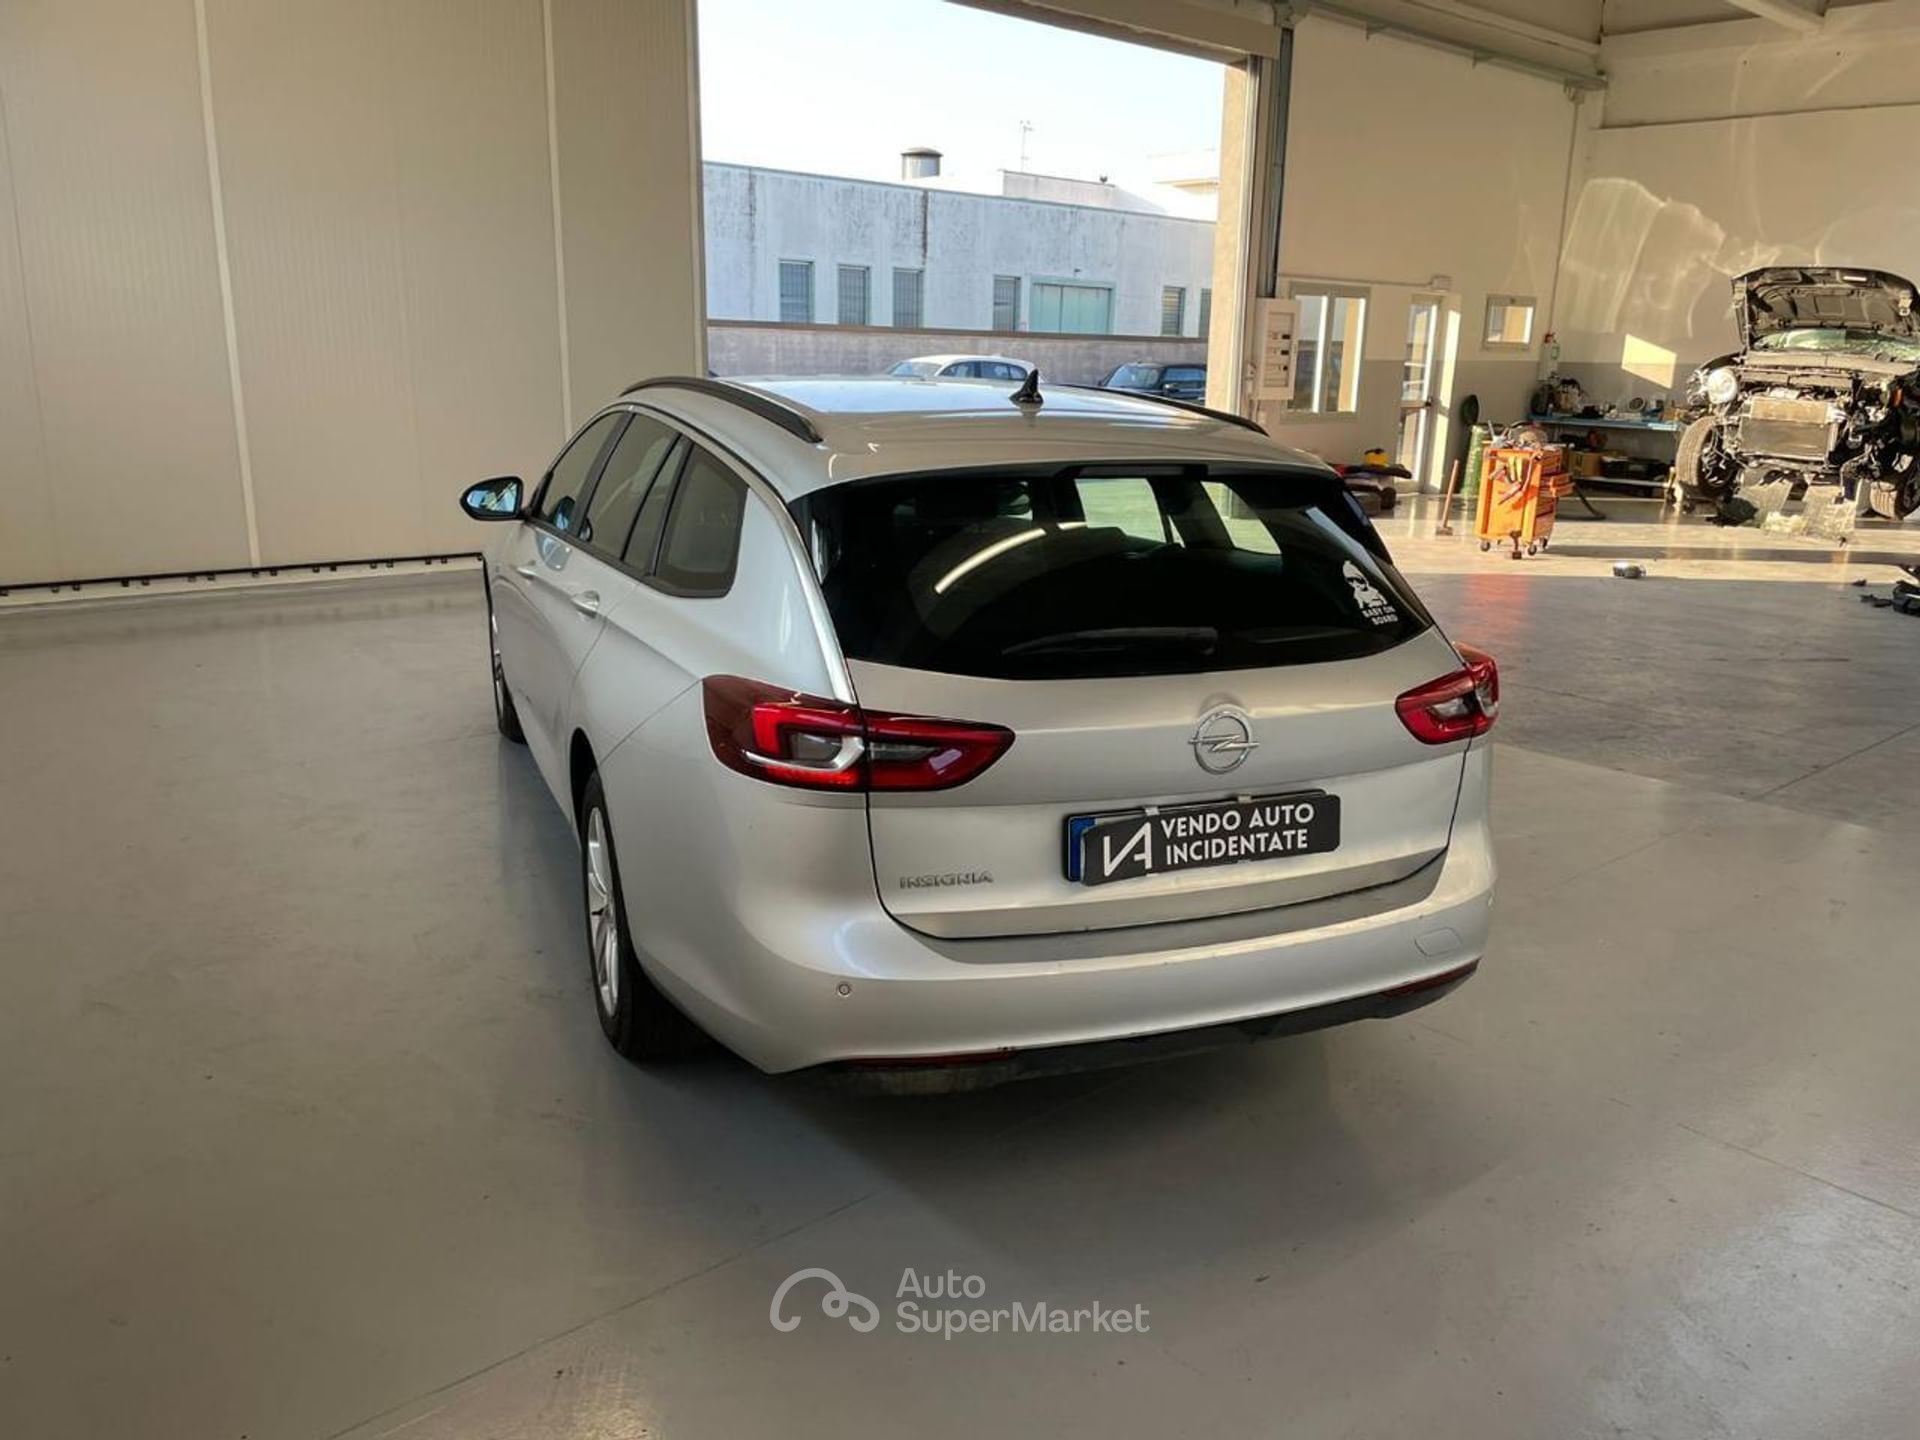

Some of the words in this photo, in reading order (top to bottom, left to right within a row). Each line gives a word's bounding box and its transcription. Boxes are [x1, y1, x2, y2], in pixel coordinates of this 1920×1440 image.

[1161, 810, 1241, 838] VENDO
[1248, 803, 1315, 828] AUTO
[1165, 829, 1309, 865] INCIDENTATE
[900, 871, 994, 889] INSIGNIA
